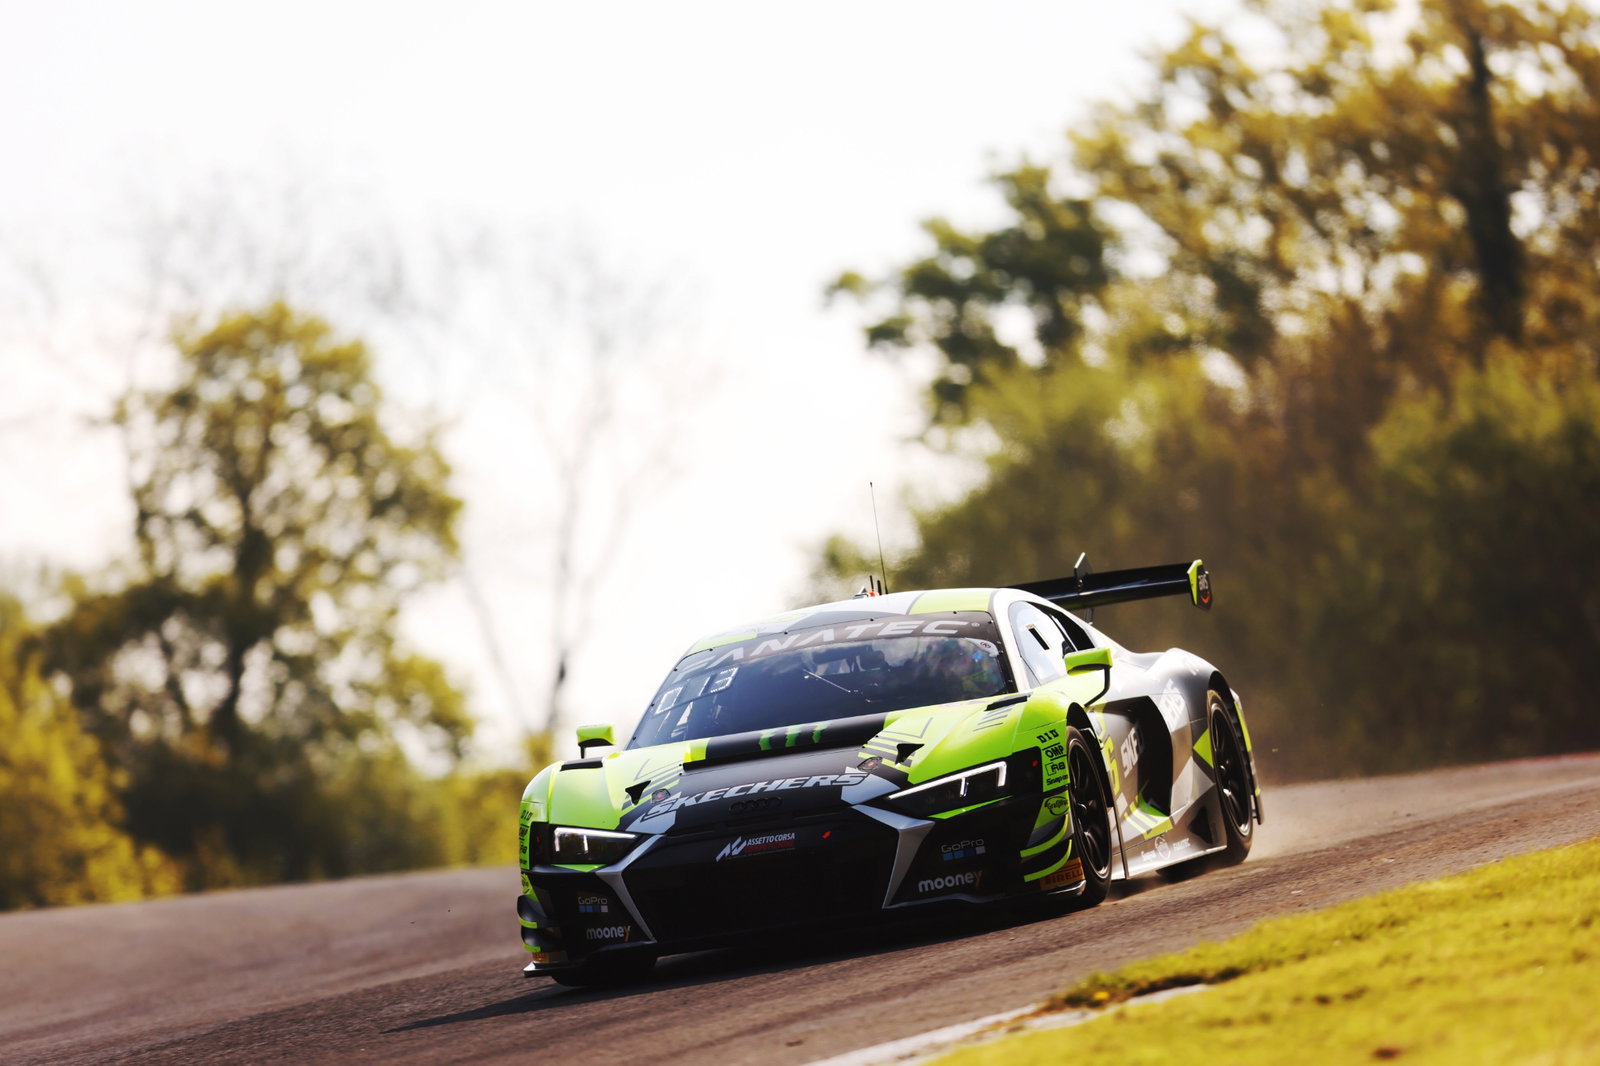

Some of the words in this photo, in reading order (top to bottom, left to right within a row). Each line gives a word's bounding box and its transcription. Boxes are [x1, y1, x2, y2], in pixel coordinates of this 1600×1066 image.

[1045, 745, 1064, 758] OMP
[642, 773, 868, 821] SKECHERS
[747, 836, 774, 847] ASSETTO
[774, 833, 796, 842] CORSA
[942, 838, 985, 853] GoPro
[918, 870, 983, 892] mooney
[578, 897, 608, 905] GoPro
[586, 925, 631, 942] mooney
